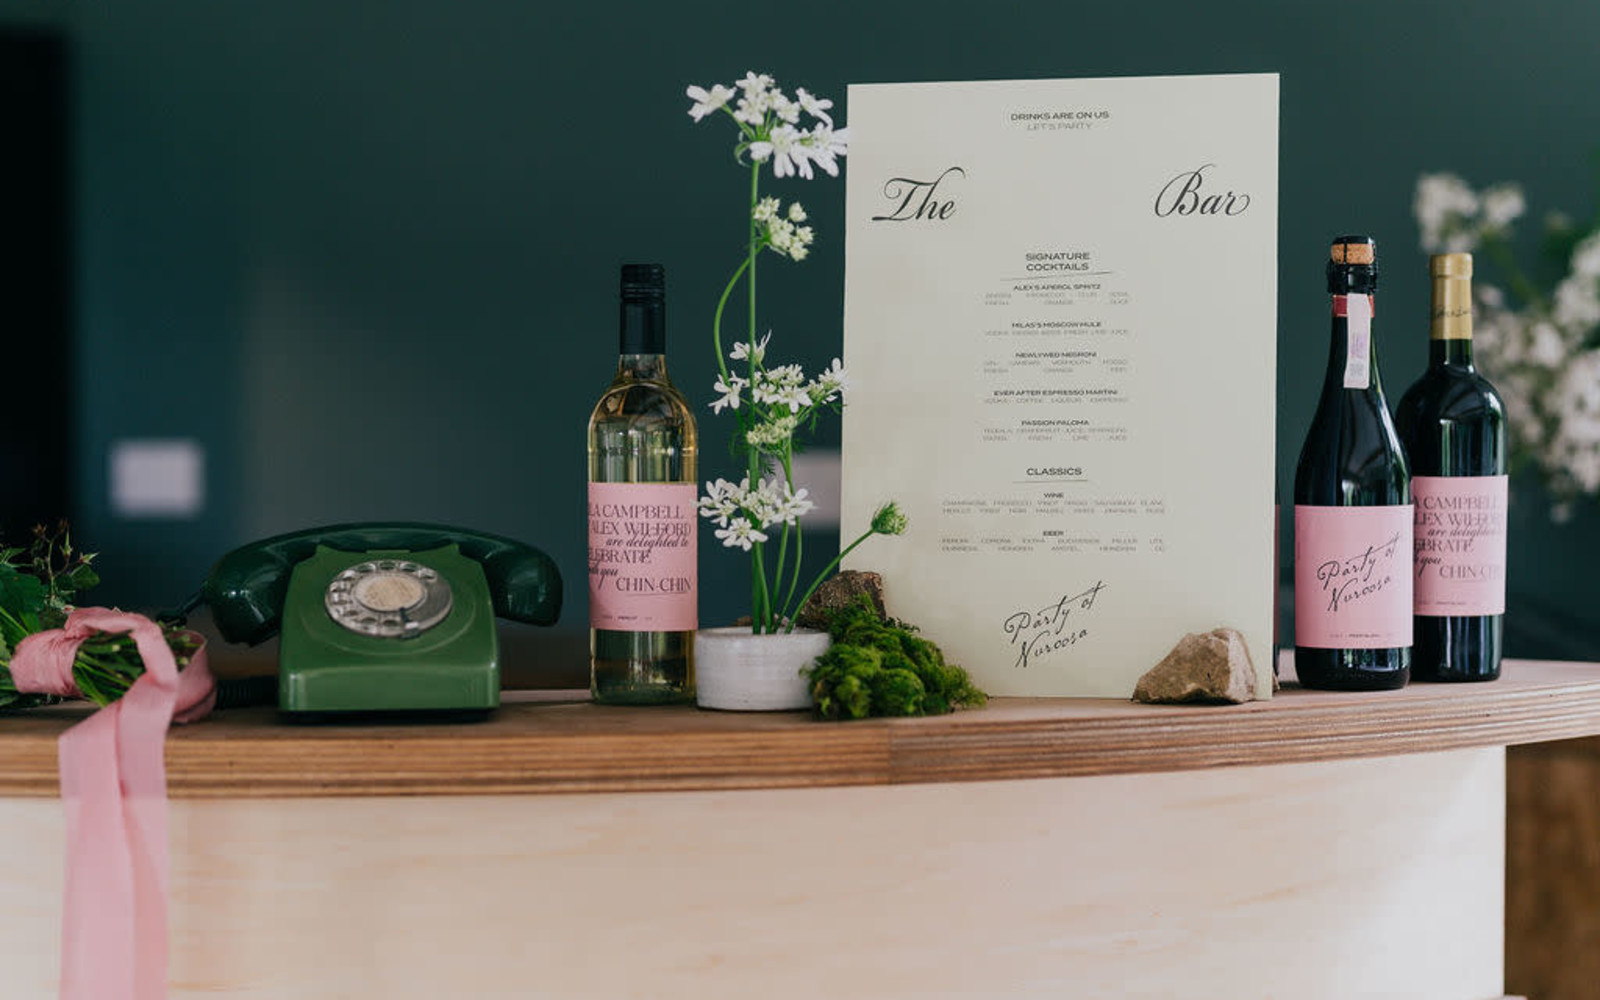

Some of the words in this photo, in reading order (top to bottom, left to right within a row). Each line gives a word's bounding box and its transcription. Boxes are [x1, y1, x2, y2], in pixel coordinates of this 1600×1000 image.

[1010, 112, 1051, 120] DRINKS
[1052, 112, 1074, 120] ARE
[1076, 111, 1093, 119] ON
[1094, 111, 1110, 119] US
[872, 166, 966, 221] The
[1154, 163, 1251, 218] Bar
[1025, 252, 1090, 261] SIGNATURE
[1026, 262, 1089, 271] COCKTAILS
[1043, 321, 1079, 329] MOSCOW
[1026, 467, 1083, 476] CLASSICS
[602, 503, 684, 519] CAMPBELL
[624, 522, 692, 537] WILFORD
[1428, 529, 1446, 538] are
[606, 538, 623, 547] are
[626, 529, 678, 553] delighted
[1316, 546, 1376, 590] Party
[616, 577, 692, 592] CHIN-CHIN
[1004, 595, 1072, 644] Party
[1080, 581, 1107, 610] at
